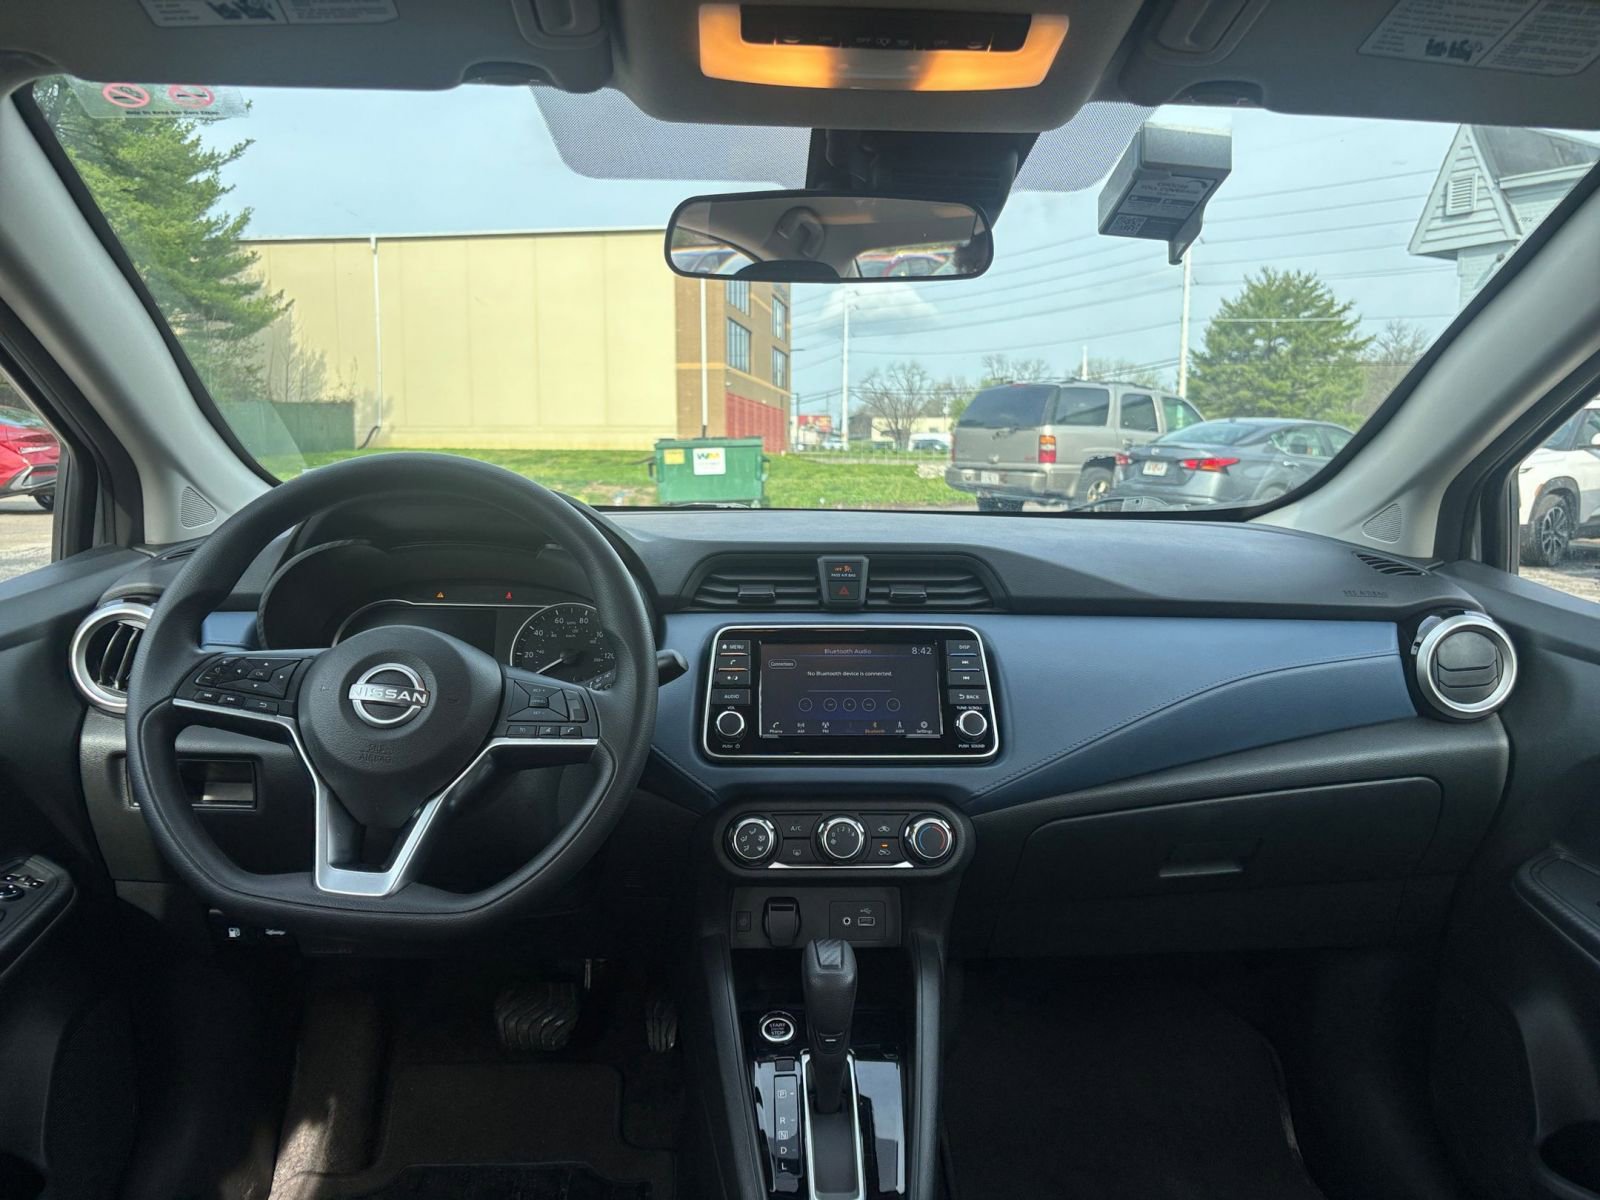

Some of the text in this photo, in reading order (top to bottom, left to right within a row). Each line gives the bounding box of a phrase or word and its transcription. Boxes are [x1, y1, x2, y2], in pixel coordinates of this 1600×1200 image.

[911, 647, 932, 655] 8:42
[352, 685, 427, 704] NISSAN
[779, 1116, 786, 1124] R
[780, 1146, 787, 1154] D
[781, 1162, 787, 1170] L
